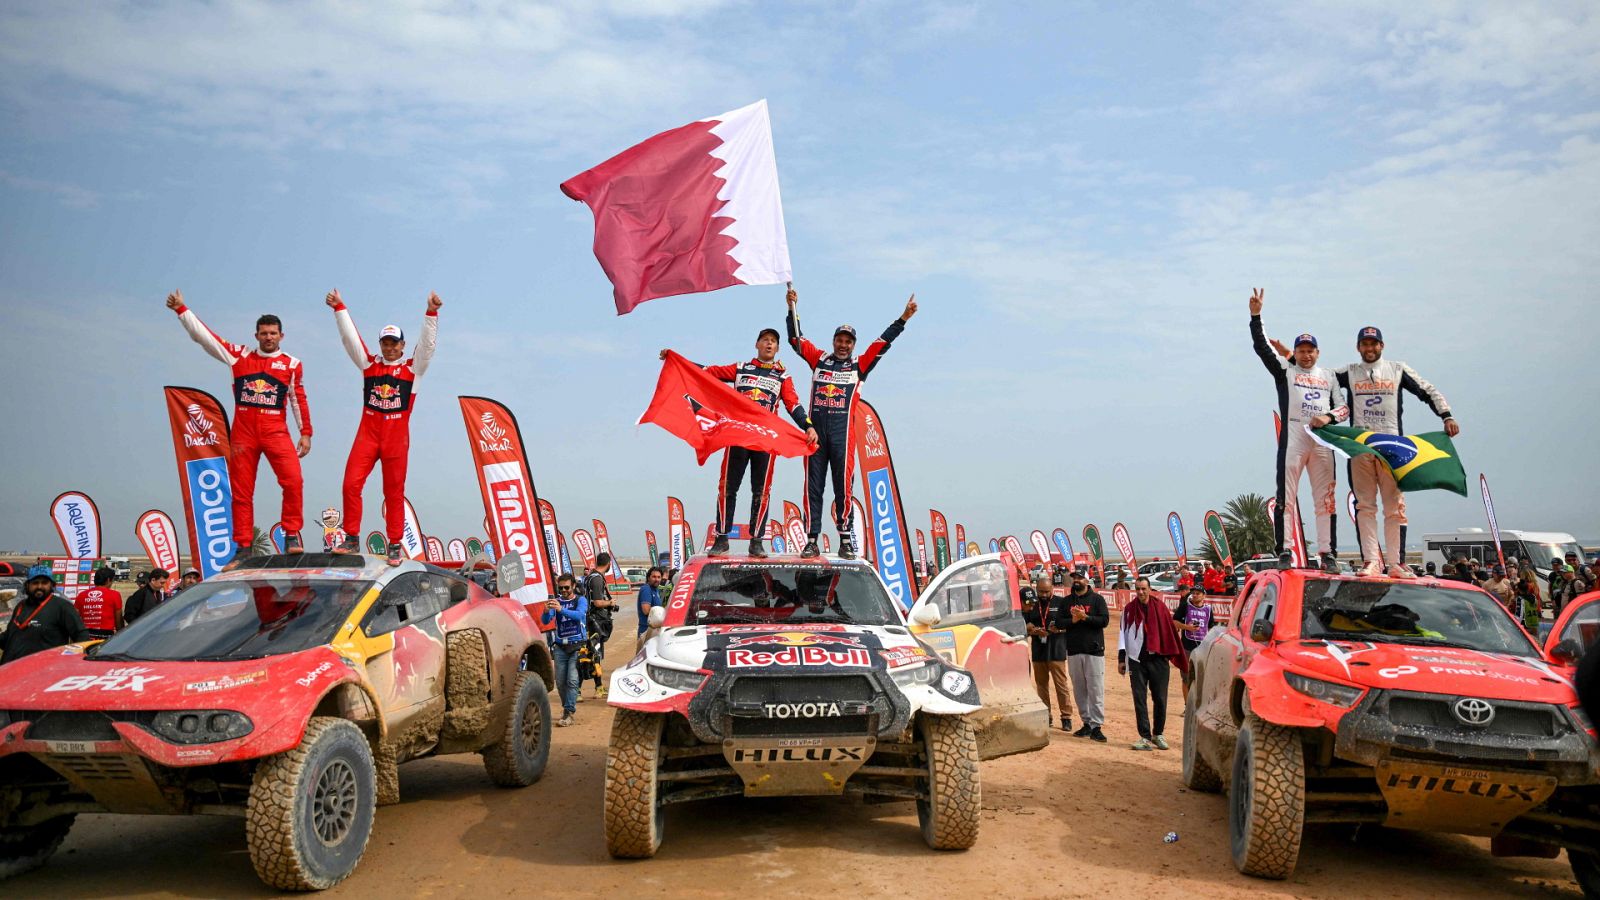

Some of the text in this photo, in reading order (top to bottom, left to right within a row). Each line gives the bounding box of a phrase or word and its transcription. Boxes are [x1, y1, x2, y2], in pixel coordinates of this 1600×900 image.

[241, 391, 277, 406] Red Bull
[383, 397, 401, 409] Bull
[814, 397, 846, 408] Red Bull
[1302, 402, 1322, 412] Pneu
[1363, 409, 1386, 417] Pneu
[1363, 417, 1386, 425] Store
[183, 431, 220, 448] DAKAR
[479, 439, 513, 453] DAKAR
[865, 444, 885, 459] DAKAR
[198, 469, 231, 572] ramco
[63, 501, 92, 558] AQUAFINA
[1171, 517, 1182, 554] aramco
[149, 521, 174, 570] MOTUL
[1008, 540, 1023, 562] MOTUL
[1057, 532, 1071, 560] aramco
[1116, 530, 1131, 558] MOTUL
[727, 647, 871, 668] Red Bull
[43, 675, 165, 693] BRX
[622, 676, 645, 695] eurol
[949, 675, 965, 692] eurol
[764, 702, 841, 719] TOYOTA
[734, 748, 862, 762] HILUX
[1387, 773, 1538, 802] HILUX
